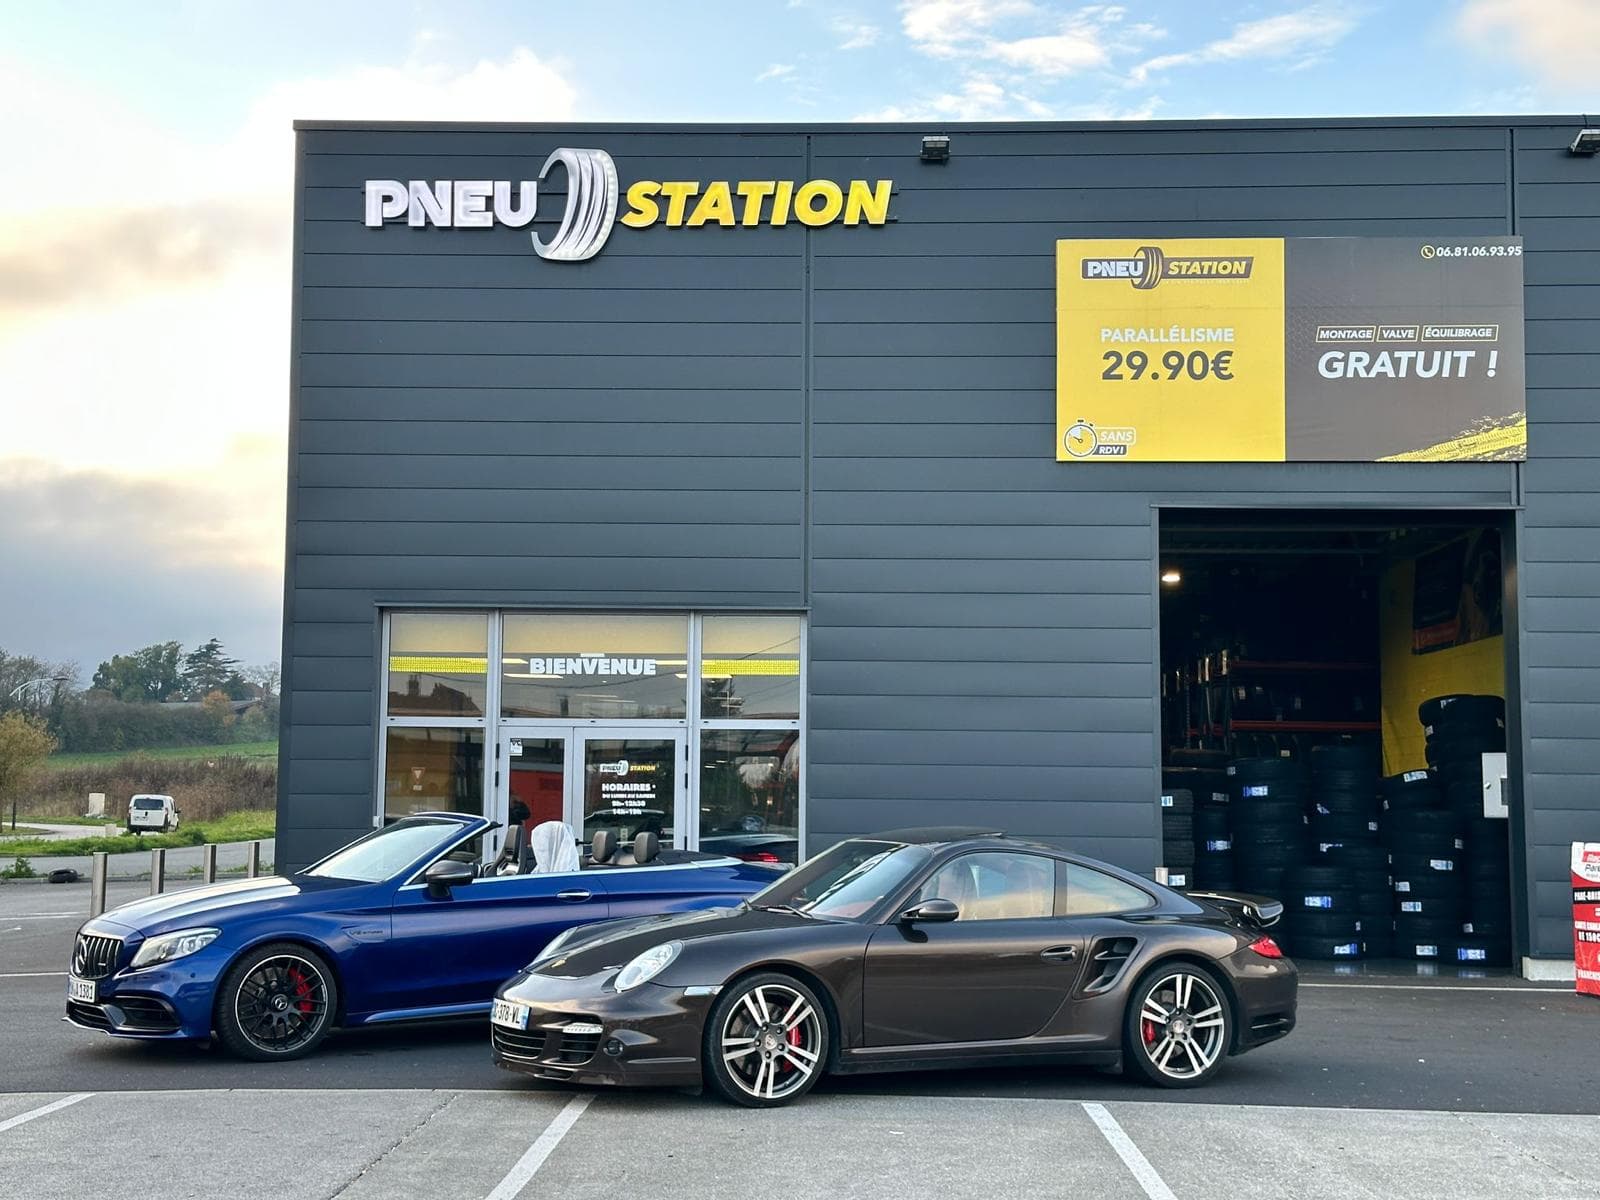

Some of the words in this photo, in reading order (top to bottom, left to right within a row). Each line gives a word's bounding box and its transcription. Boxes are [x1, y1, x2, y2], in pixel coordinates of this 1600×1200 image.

[365, 180, 538, 228] PNEU
[620, 180, 893, 228] STATION
[1436, 246, 1523, 257] 06.81.06.93.95
[1087, 261, 1144, 277] PNEU
[1167, 261, 1247, 275] STATION
[1101, 325, 1235, 342] PARALLÉLISME
[1319, 330, 1373, 339] MONTAGE
[1382, 329, 1415, 338] VALVE
[1424, 327, 1492, 338] ÉQUILIBRAGE
[1102, 350, 1234, 380] 29.90€
[1318, 350, 1476, 379] GRATUIT
[1486, 350, 1498, 378] !
[1100, 431, 1134, 443] SANS
[529, 658, 657, 675] BIENVENUE
